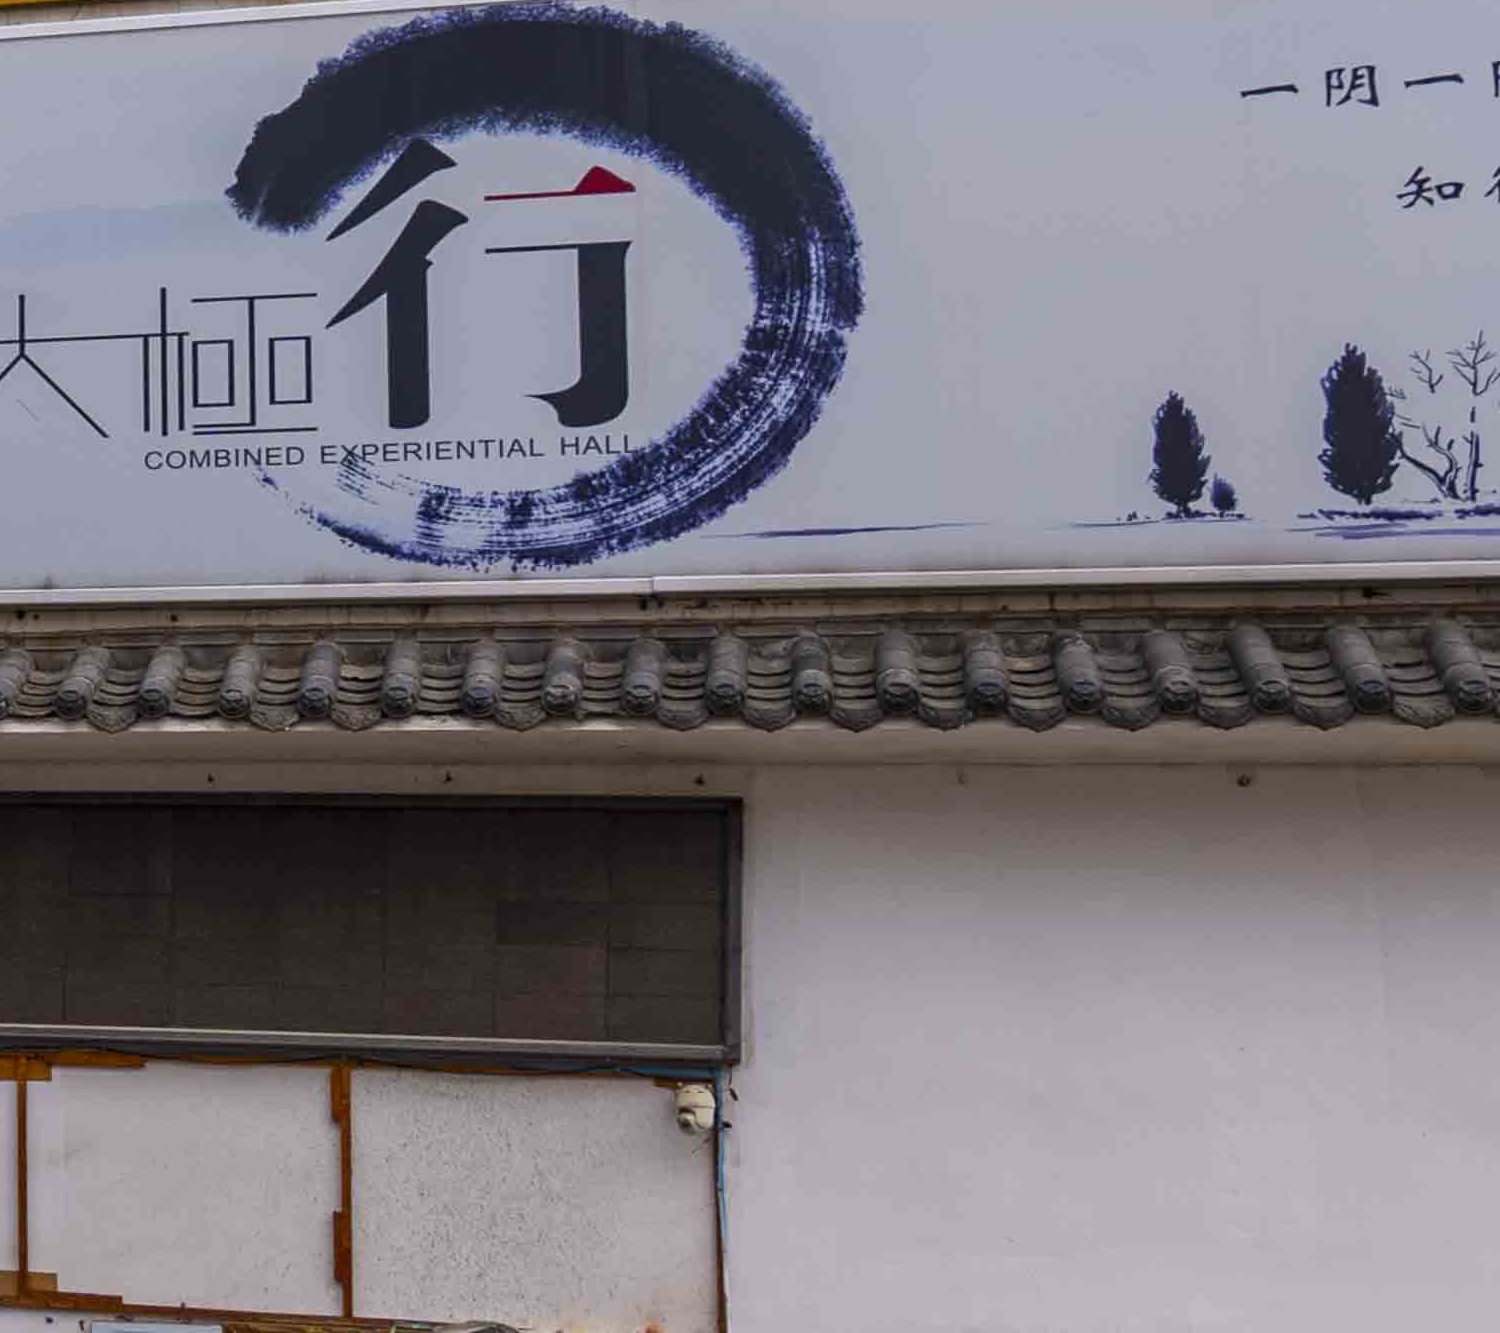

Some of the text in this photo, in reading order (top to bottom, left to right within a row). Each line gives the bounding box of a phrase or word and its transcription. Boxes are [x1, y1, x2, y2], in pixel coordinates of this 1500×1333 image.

[1240, 60, 1500, 108] 一阴一
[1396, 166, 1500, 209] 知
[143, 432, 638, 471] COMBINED EXPERIENTIAL HALL
